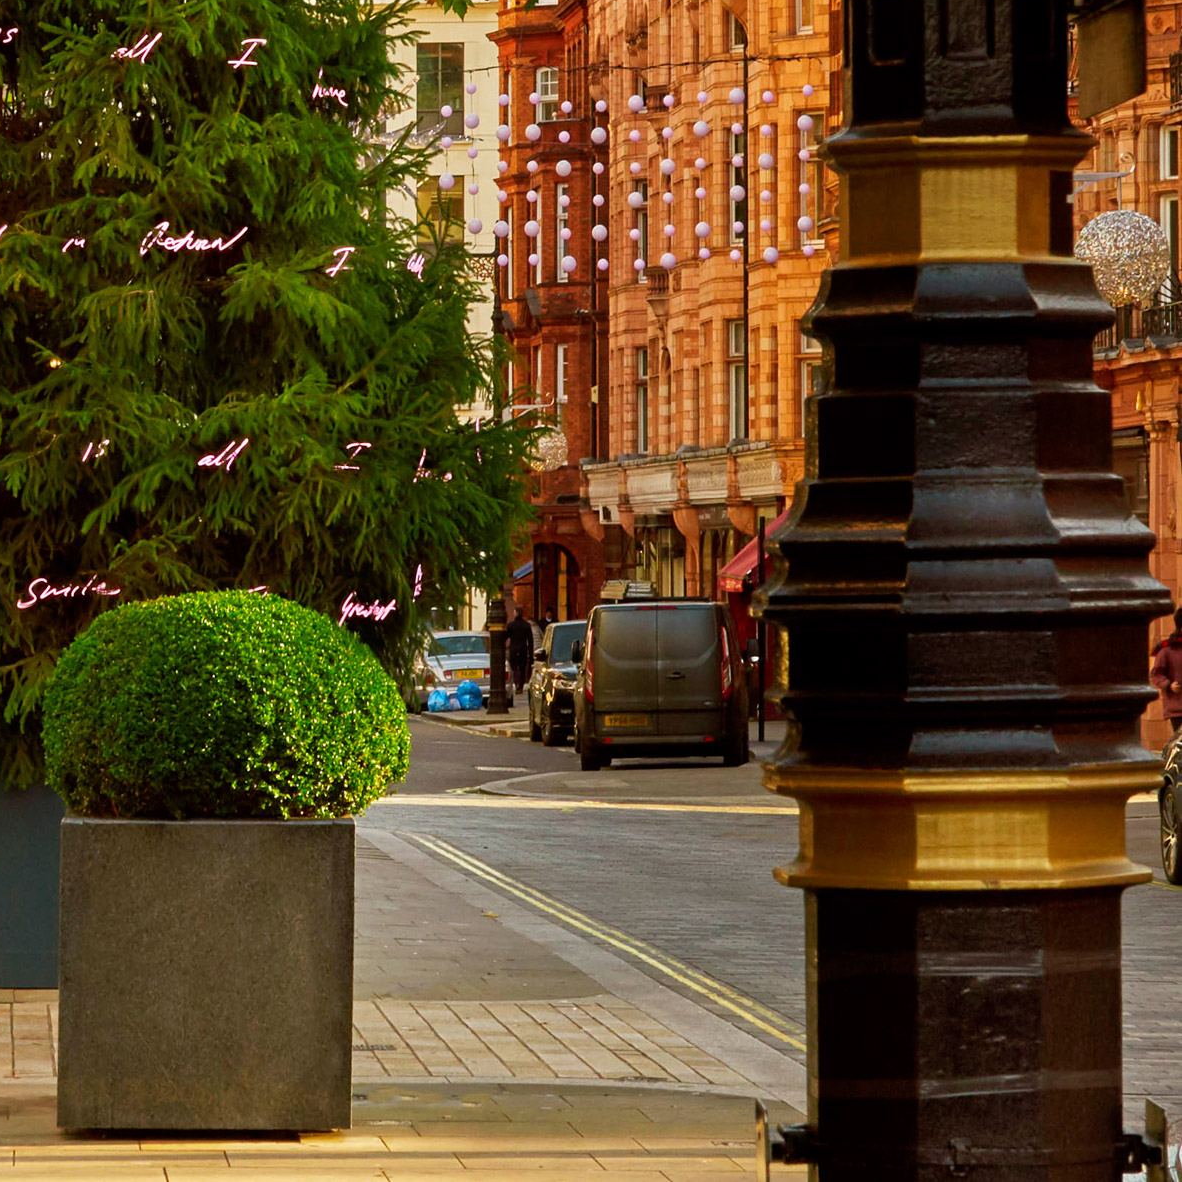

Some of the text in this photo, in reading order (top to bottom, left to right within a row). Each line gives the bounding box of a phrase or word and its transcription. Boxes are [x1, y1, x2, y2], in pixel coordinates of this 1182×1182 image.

[110, 31, 163, 65] all
[227, 37, 268, 69] I
[325, 246, 356, 278] I
[197, 437, 249, 472] all
[334, 442, 372, 470] I
